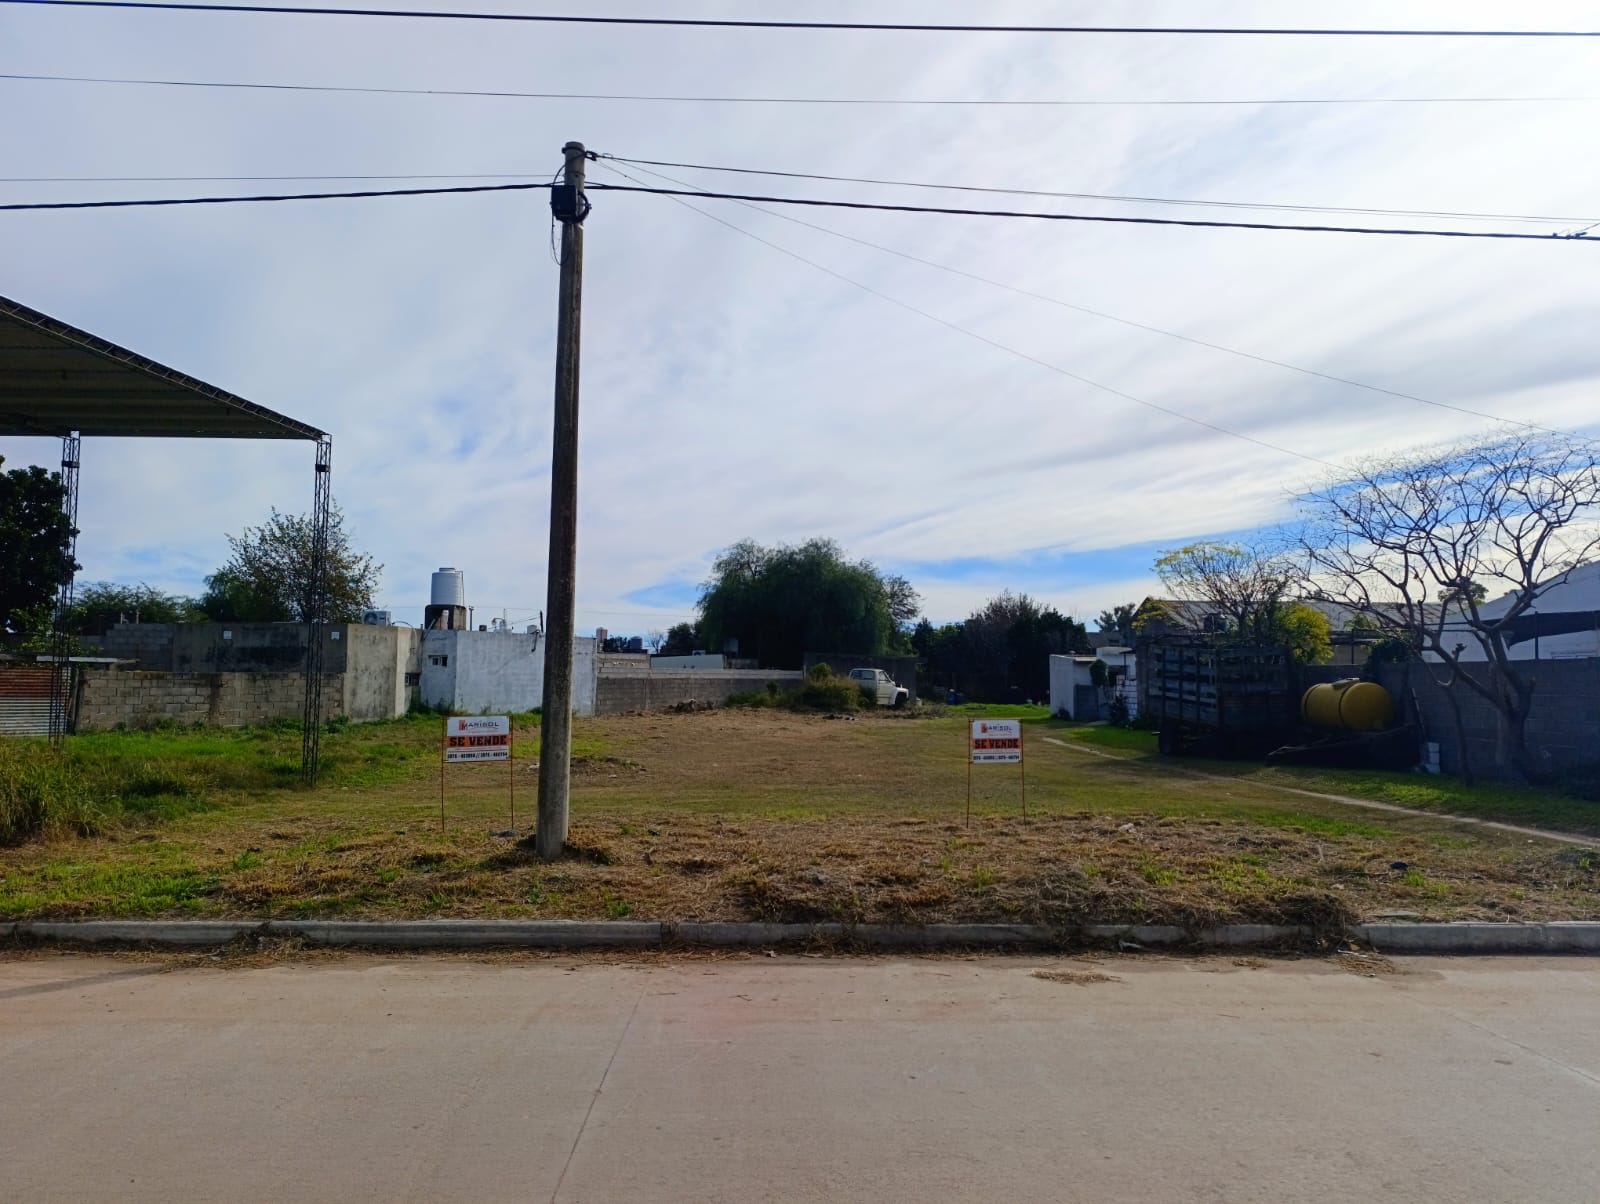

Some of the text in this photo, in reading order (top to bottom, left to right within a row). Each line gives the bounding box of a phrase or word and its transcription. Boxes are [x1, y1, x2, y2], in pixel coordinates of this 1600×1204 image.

[450, 735, 506, 746] SE VENDE
[975, 739, 1018, 749] SE VENDE
